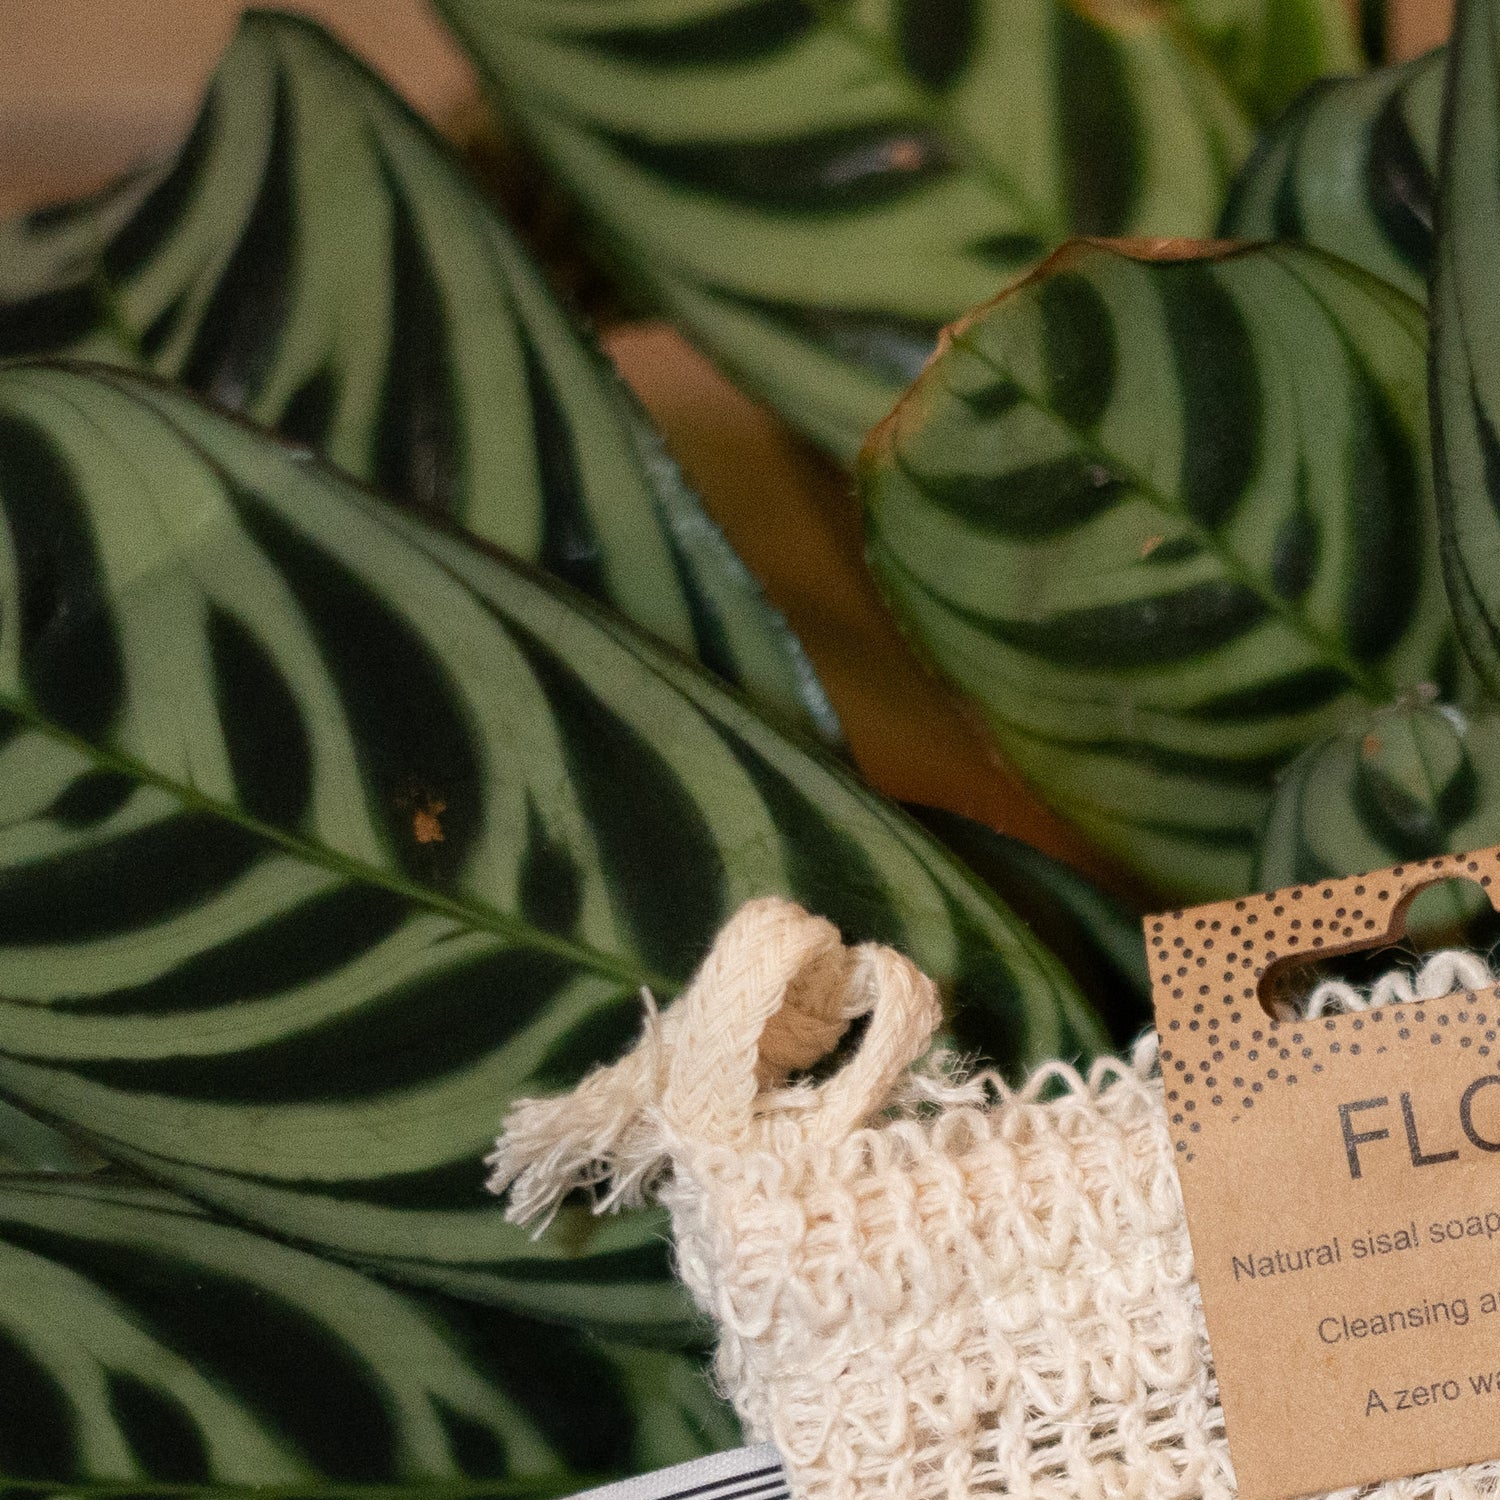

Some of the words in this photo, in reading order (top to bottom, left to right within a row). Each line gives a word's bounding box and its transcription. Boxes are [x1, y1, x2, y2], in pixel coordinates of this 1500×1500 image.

[1231, 1237, 1342, 1283] Natural
[1351, 1220, 1420, 1260] sisal
[1317, 1295, 1470, 1345] Cleansing
[1364, 1387, 1389, 1418] A
[1394, 1380, 1462, 1412] zero
